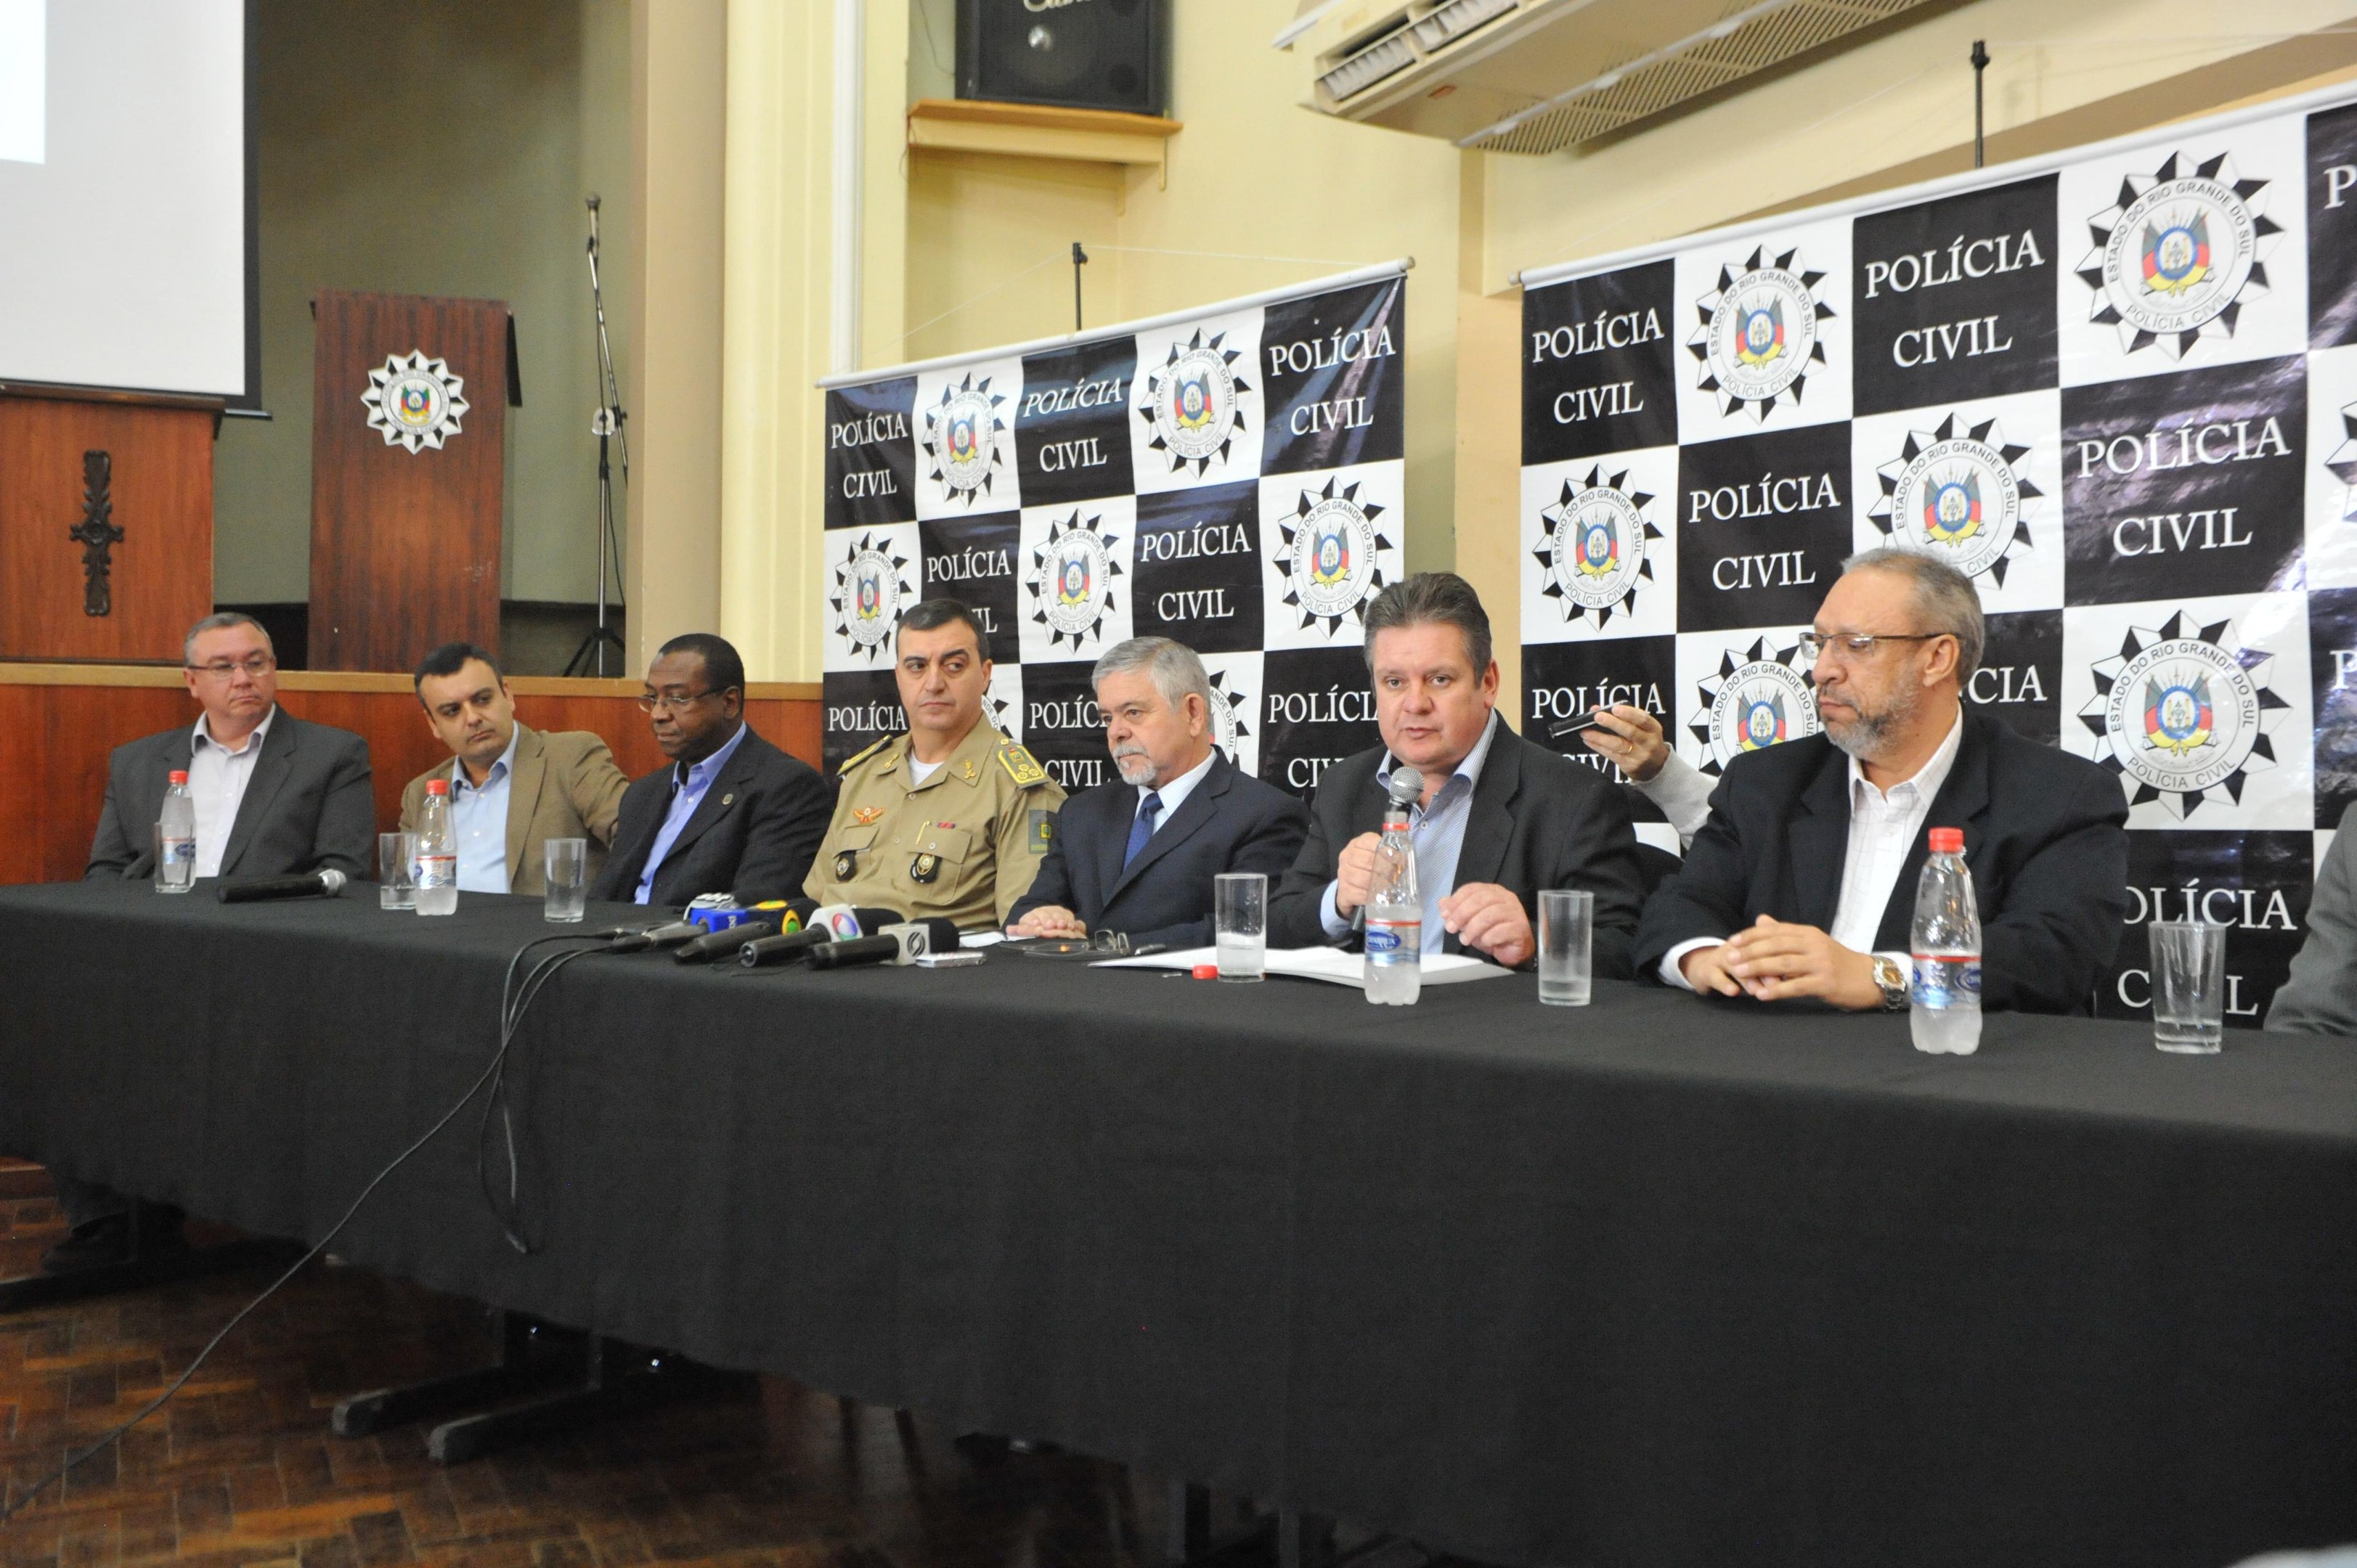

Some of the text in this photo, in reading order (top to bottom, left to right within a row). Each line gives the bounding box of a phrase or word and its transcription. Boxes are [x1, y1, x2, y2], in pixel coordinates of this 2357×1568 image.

[2107, 182, 2252, 282] ESTADO DO RIO GRANDE DO SUL
[1866, 229, 2045, 298] POLÍCIA
[1711, 271, 1812, 356] ESTADO DO RIO GRANDE DO SUL
[2126, 295, 2231, 330] POLÍCIA CIVIL
[1269, 326, 1396, 376] POLÍCIA
[1533, 308, 1664, 363] POLÍCIA
[1894, 316, 2013, 367] CIVIL
[1023, 376, 1123, 417] POLÍCIA
[1156, 377, 1168, 419] ESTADO
[1169, 364, 1180, 376] DO
[1181, 353, 1195, 364] RIO
[1197, 351, 1223, 371] GRANDE
[1219, 369, 1229, 385] DO
[1554, 381, 1644, 424] CIVIL
[1722, 367, 1799, 397] POLÍCIA CIVIL
[831, 412, 908, 449] POLÍCIA
[1290, 396, 1374, 436] CIVIL
[1039, 438, 1107, 472] CIVIL
[1168, 433, 1226, 456] POLÍCIA CIVIL
[2077, 416, 2292, 479] POLÍCIA
[843, 469, 897, 499] CIVIL
[1689, 473, 1841, 523] POLÍCIA
[1895, 442, 2016, 530] ESTADO DO RIO GRANDE DO SUL
[1141, 520, 1252, 563] POLÍCIA
[1294, 528, 1306, 573] ESTADO
[1304, 513, 1316, 528] DO
[1316, 502, 1331, 514] RIO
[1332, 501, 1364, 524] GRANDE
[1361, 524, 1371, 540] DO
[1555, 518, 1567, 564] ESTADO
[1566, 502, 1579, 517] DO
[1579, 491, 1595, 505] RIO
[1597, 490, 1632, 513] GRANDE
[1629, 512, 1640, 529] DO
[2113, 507, 2253, 557] CIVIL
[927, 546, 1011, 582] POLÍCIA
[1041, 555, 1052, 594] ESTADO
[1052, 543, 1062, 553] DO
[1063, 533, 1075, 543] RIO
[1077, 531, 1101, 550] GRANDE
[1099, 550, 1107, 566] DO
[1712, 550, 1816, 590] CIVIL
[1967, 548, 2000, 573] CIVIL
[1158, 589, 1234, 621] CIVIL
[1301, 590, 1361, 614] POLÍCIA CIVIL
[1565, 581, 1631, 606] POLÍCIA CIVIL
[1049, 611, 1099, 632] POLÍCIA CIVIL
[1268, 684, 1378, 723] POLÍCI
[1712, 692, 1728, 740] ESTADO
[1726, 676, 1741, 691] DO
[1741, 665, 1759, 679] RIO
[1762, 663, 1802, 691] GRANDE
[1799, 691, 1812, 710] DO
[2110, 642, 2255, 732] ESTADO DO RIO GRANDE DO SUL
[828, 700, 908, 732] POLÍCIA
[1029, 694, 1107, 729] POLÍC
[2127, 756, 2236, 788] POLÍCIA CIVIL
[2123, 878, 2298, 930] OLÍCIA
